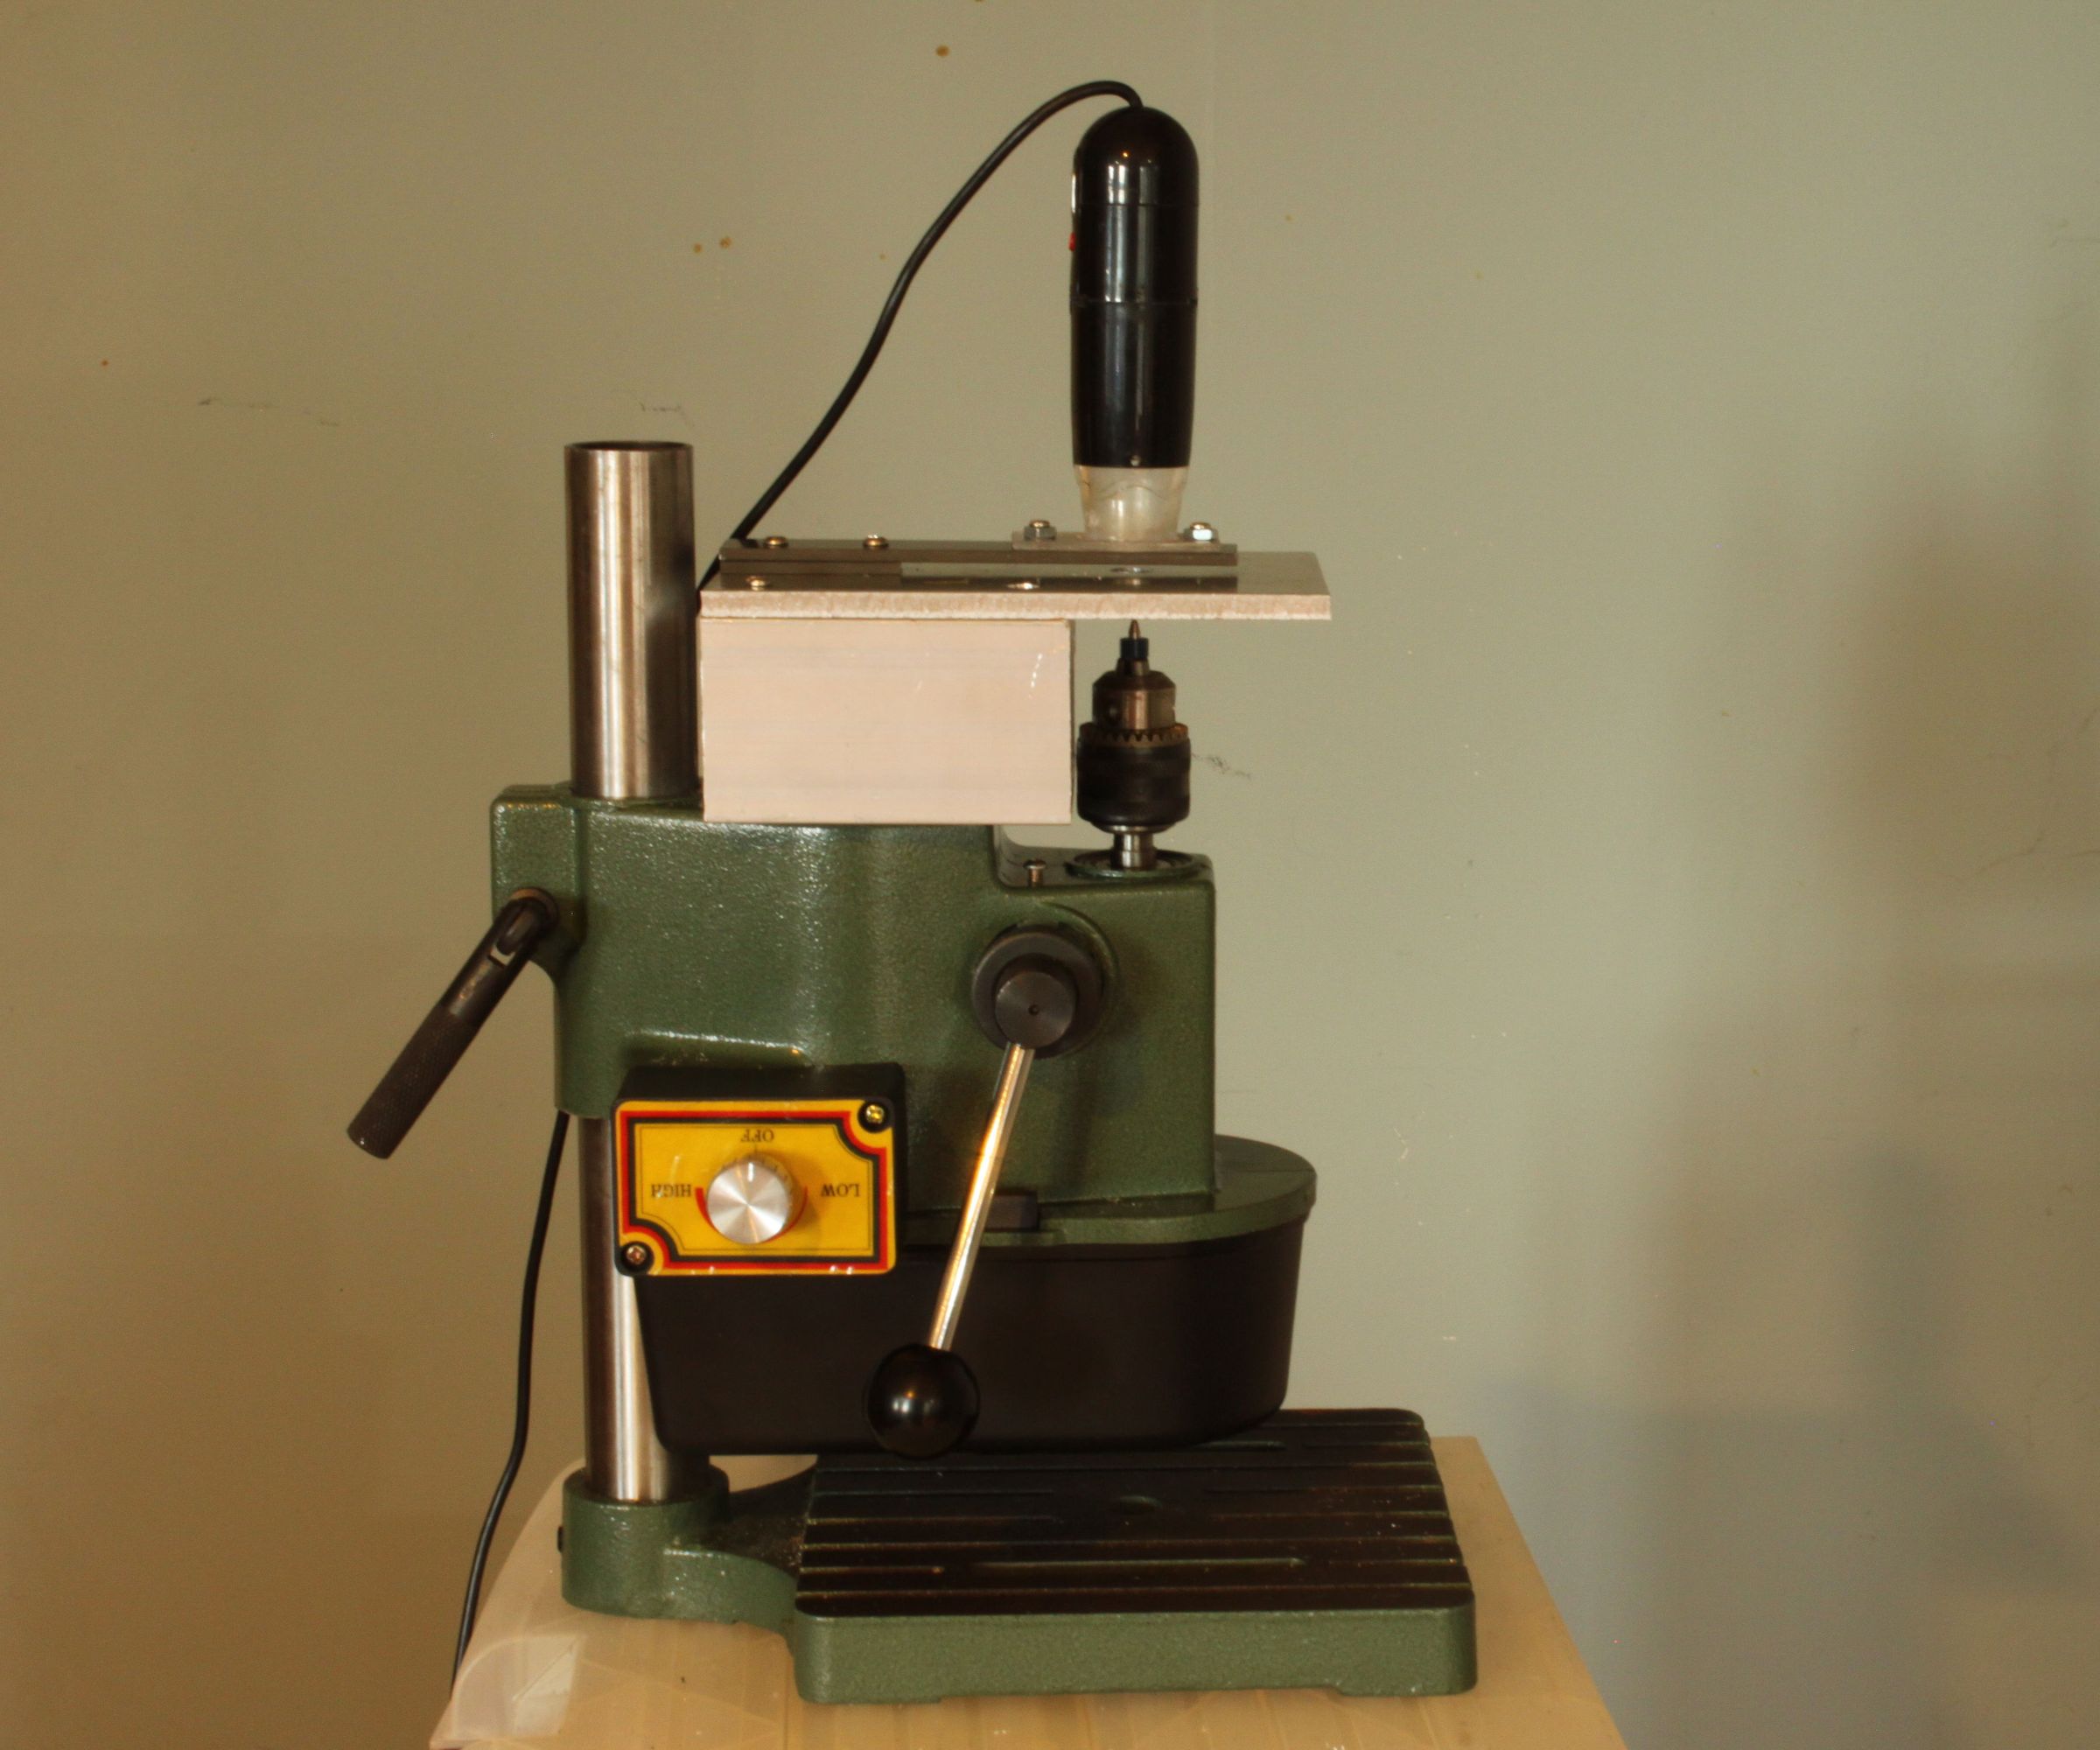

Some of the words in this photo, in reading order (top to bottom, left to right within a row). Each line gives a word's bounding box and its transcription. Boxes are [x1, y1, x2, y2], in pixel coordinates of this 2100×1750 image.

[740, 1129, 774, 1142] OFF
[651, 1184, 691, 1198] HIGH
[821, 1184, 860, 1198] LOW
